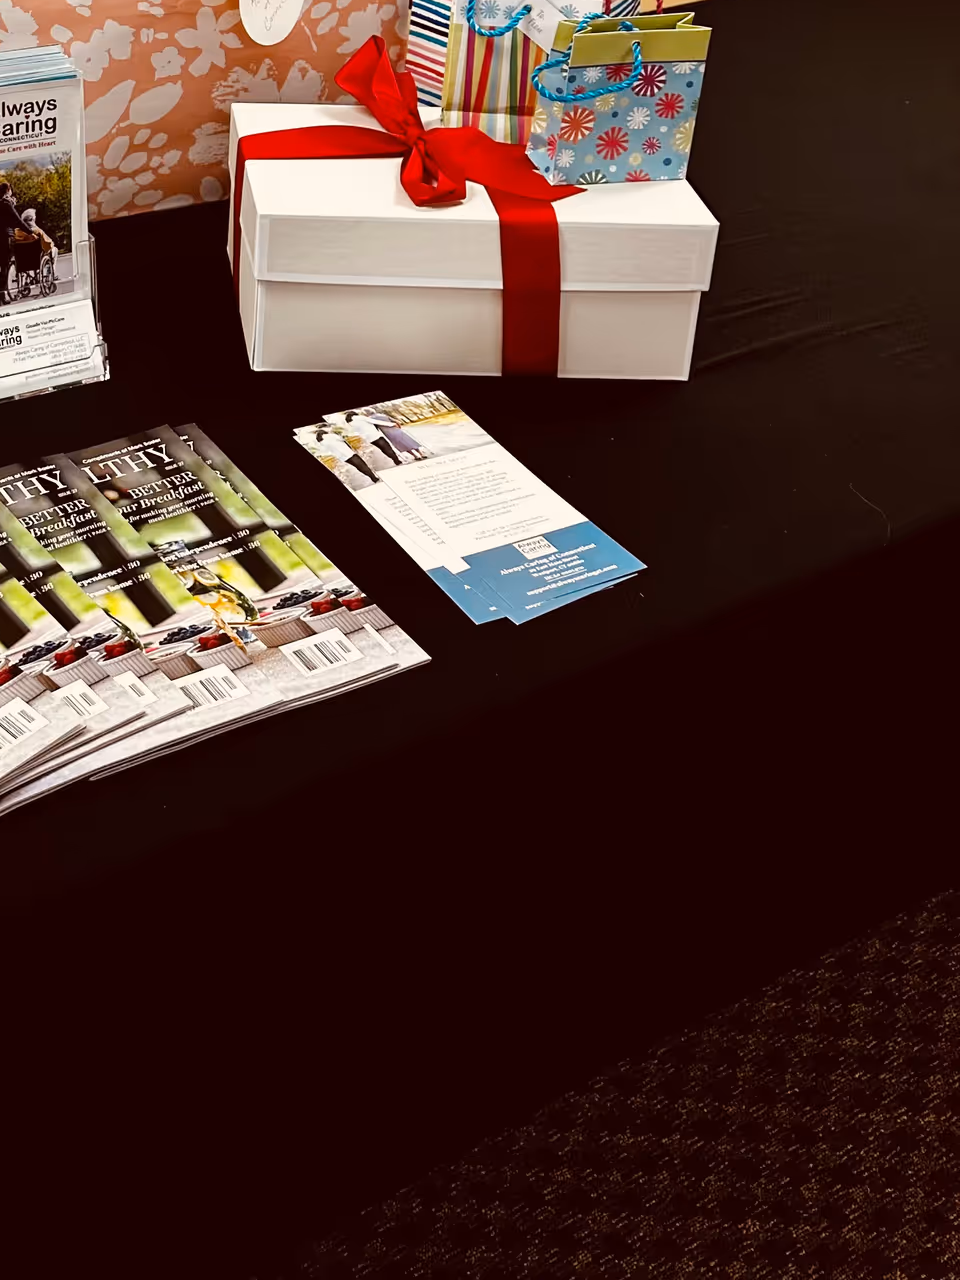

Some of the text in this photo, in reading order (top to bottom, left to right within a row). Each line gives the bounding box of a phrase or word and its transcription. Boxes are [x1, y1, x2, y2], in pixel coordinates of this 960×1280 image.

[0, 132, 44, 145] CONNECTICUT
[7, 144, 22, 153] Care
[23, 141, 38, 151] with
[38, 138, 57, 149] Heart
[127, 471, 198, 500] BETTER
[139, 480, 206, 510] Breakfast
[18, 498, 91, 529] BETTER
[141, 507, 168, 520] making
[184, 491, 215, 506] morning
[30, 509, 98, 538] Breakfast
[74, 519, 107, 535] morning
[237, 528, 250, 539] 30
[220, 547, 244, 560] home
[248, 540, 261, 550] 36
[517, 538, 546, 550] Always
[521, 543, 552, 555] Caring
[127, 560, 141, 571] 30
[500, 567, 526, 577] Always
[525, 558, 549, 569] Caring
[30, 570, 43, 581] 30
[109, 572, 152, 595] home 36
[41, 582, 54, 594] 36
